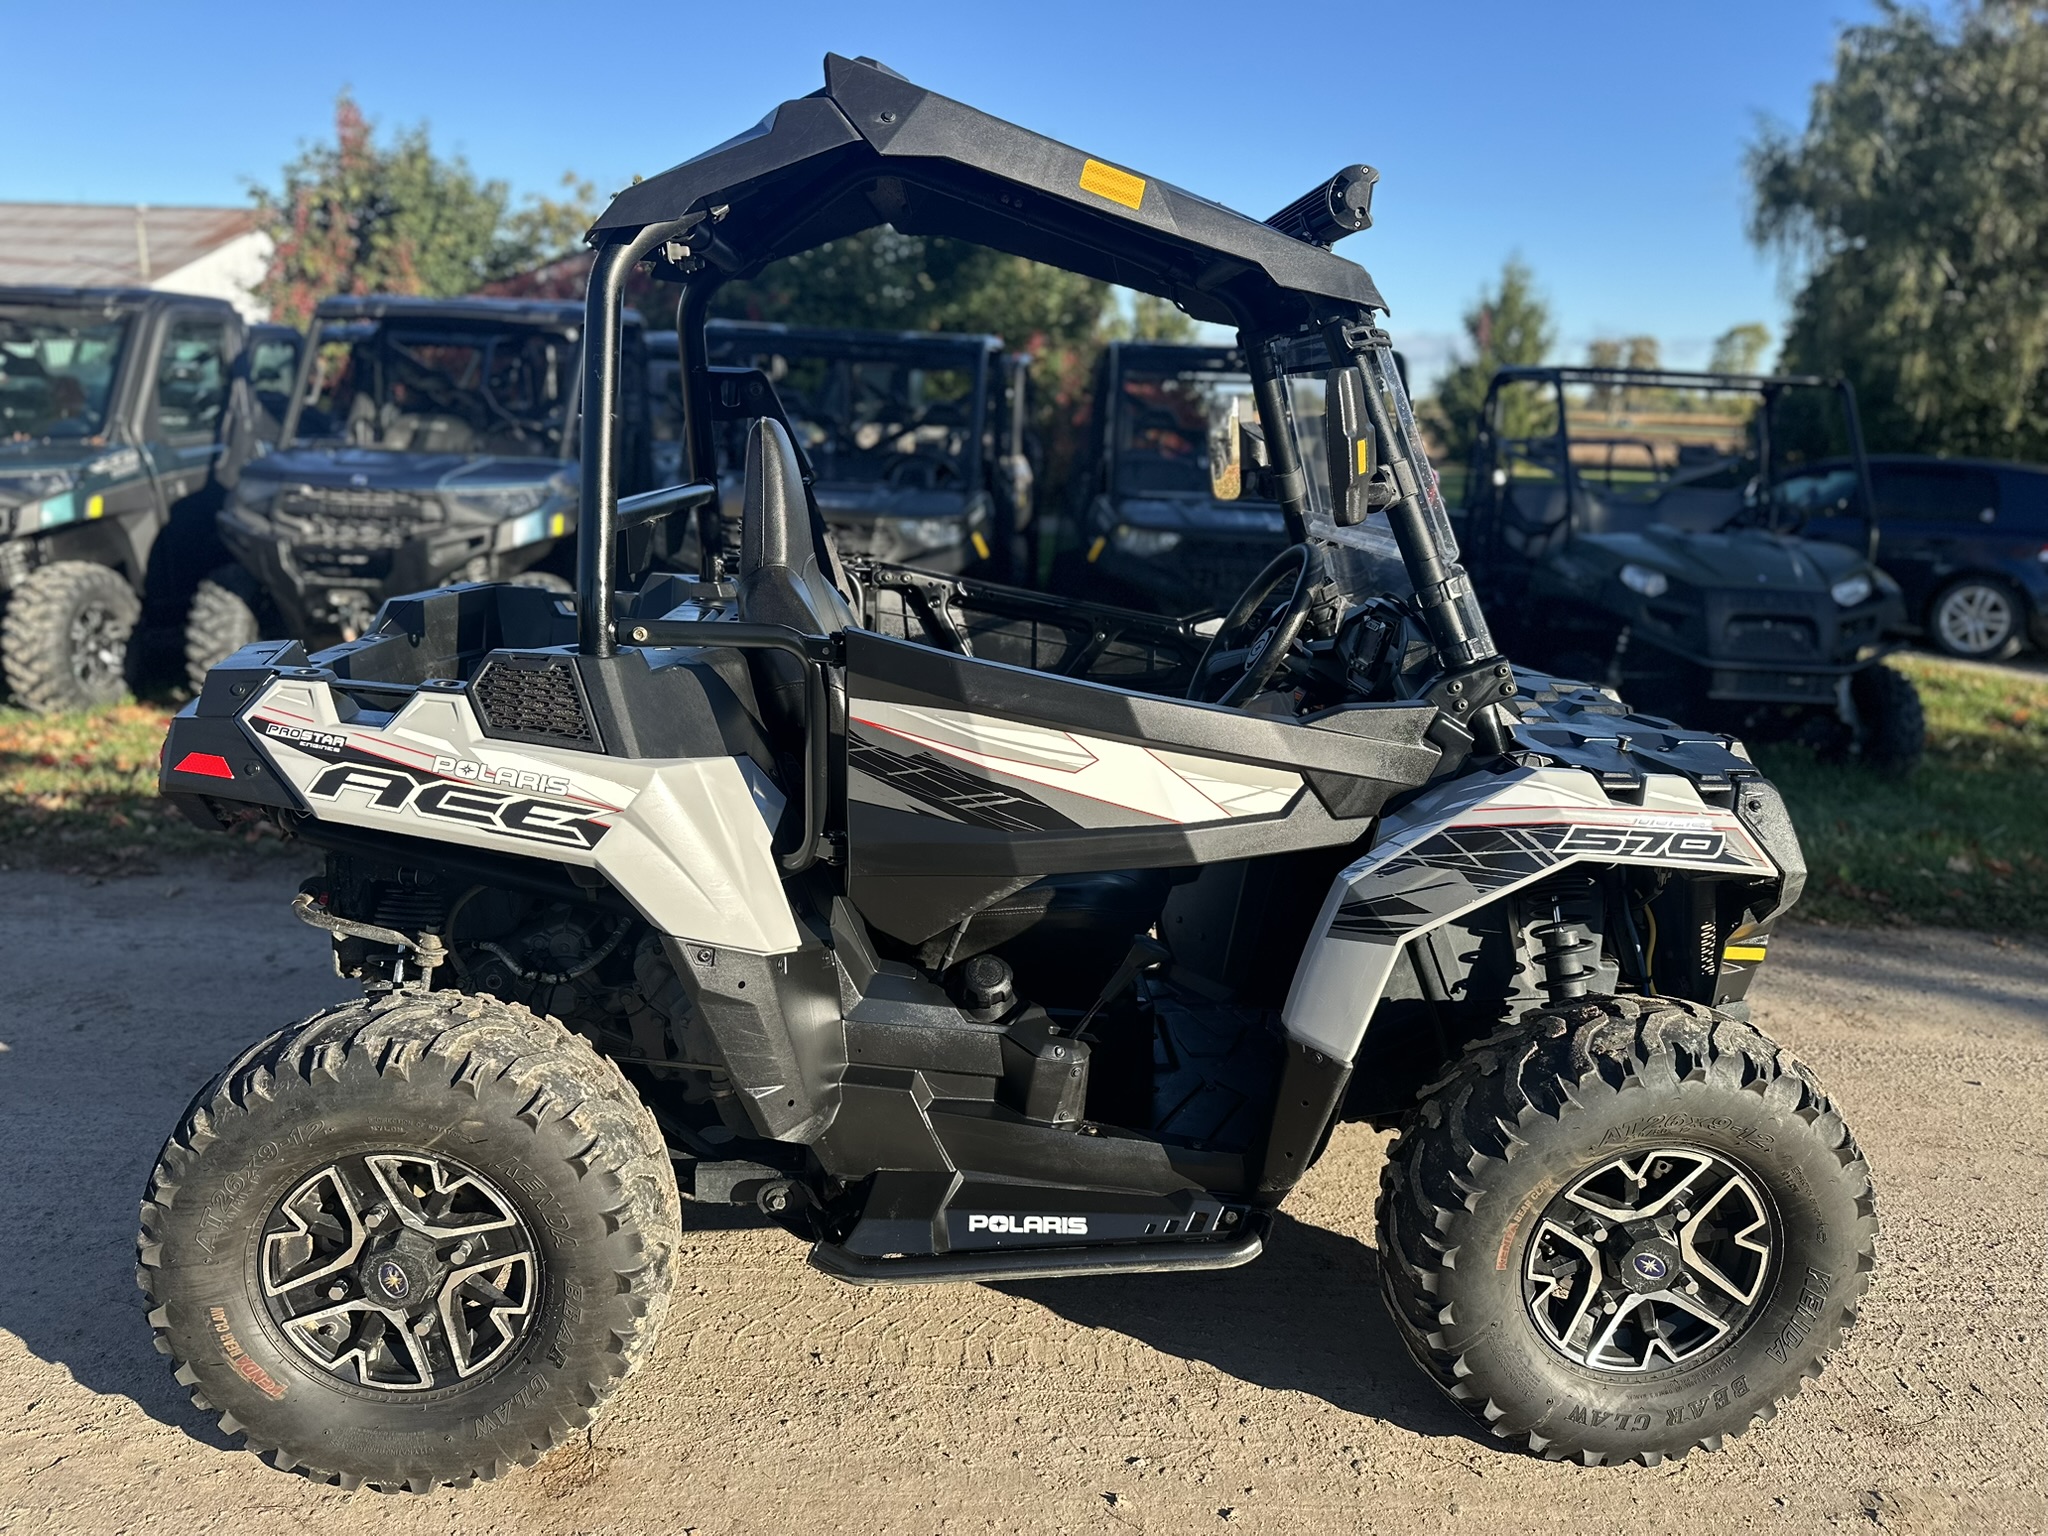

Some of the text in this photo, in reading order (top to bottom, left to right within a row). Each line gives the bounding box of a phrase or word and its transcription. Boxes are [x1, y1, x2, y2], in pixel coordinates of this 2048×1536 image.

[266, 723, 347, 747] PROSTAR
[299, 741, 341, 753] ENGINES
[431, 755, 570, 796] POLARIS
[305, 761, 612, 850] ACE
[1553, 824, 1726, 859] 570
[1513, 1200, 1533, 1223] BEAR
[1531, 1177, 1553, 1200] CLAW
[968, 1214, 1089, 1235] POLARIS
[210, 1307, 230, 1332] CLAW
[546, 1278, 584, 1370] BEAR
[1765, 1266, 1832, 1365] KENDA
[220, 1332, 244, 1358] BEAR
[474, 1372, 550, 1440] CLAW
[1564, 1404, 1651, 1432] CLAW
[1665, 1375, 1750, 1427] BEAR
